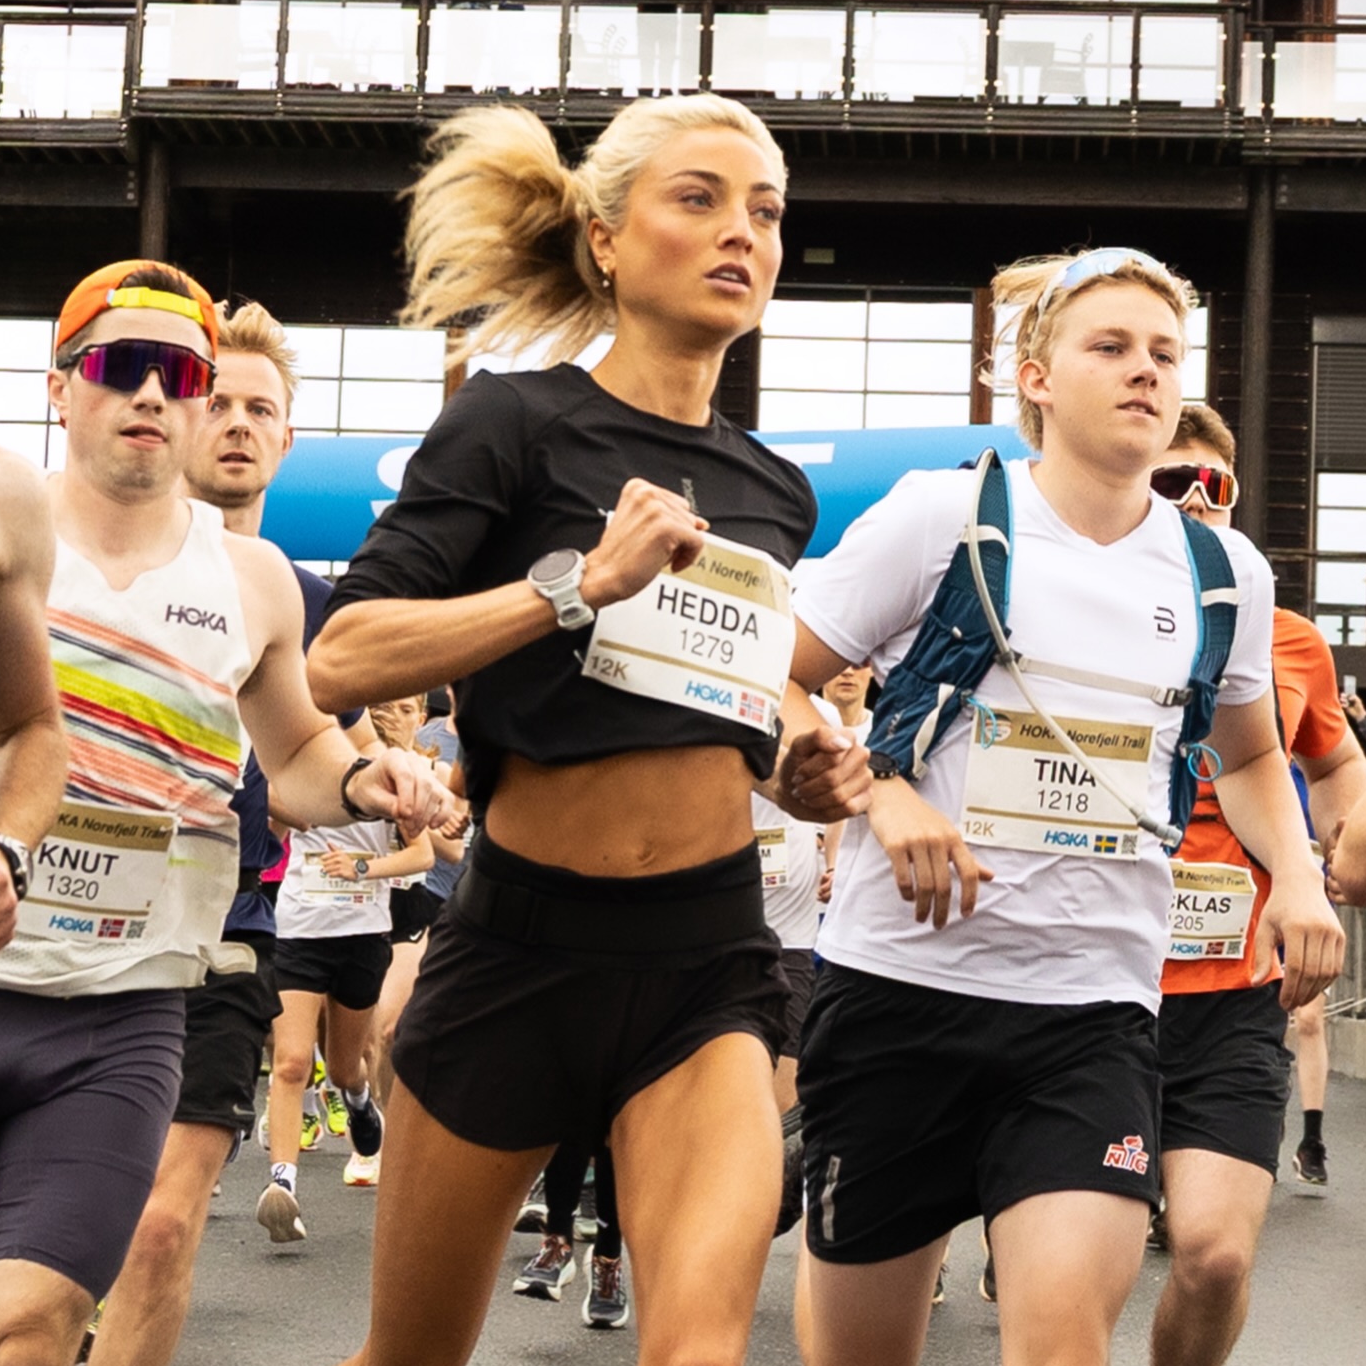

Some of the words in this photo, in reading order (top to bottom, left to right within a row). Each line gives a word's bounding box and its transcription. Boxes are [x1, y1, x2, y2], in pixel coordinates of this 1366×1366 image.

[164, 604, 228, 635] HOKA
[657, 584, 759, 640] HEDDA
[680, 628, 734, 665] 1279
[590, 655, 629, 680] 12K
[685, 680, 733, 709] HOKA
[1020, 724, 1056, 740] HOK
[1122, 736, 1146, 749] Trail
[1037, 790, 1089, 813] 1218
[57, 813, 78, 827] KA
[81, 818, 138, 838] Norefjell
[964, 821, 995, 838] 12K
[1044, 831, 1089, 848] HOKA
[38, 843, 119, 876] KNUT
[47, 874, 99, 900] 1320
[1171, 894, 1231, 914] KLAS
[48, 915, 94, 933] HOKA
[1168, 914, 1204, 931] 205
[1171, 943, 1203, 954] HOKA
